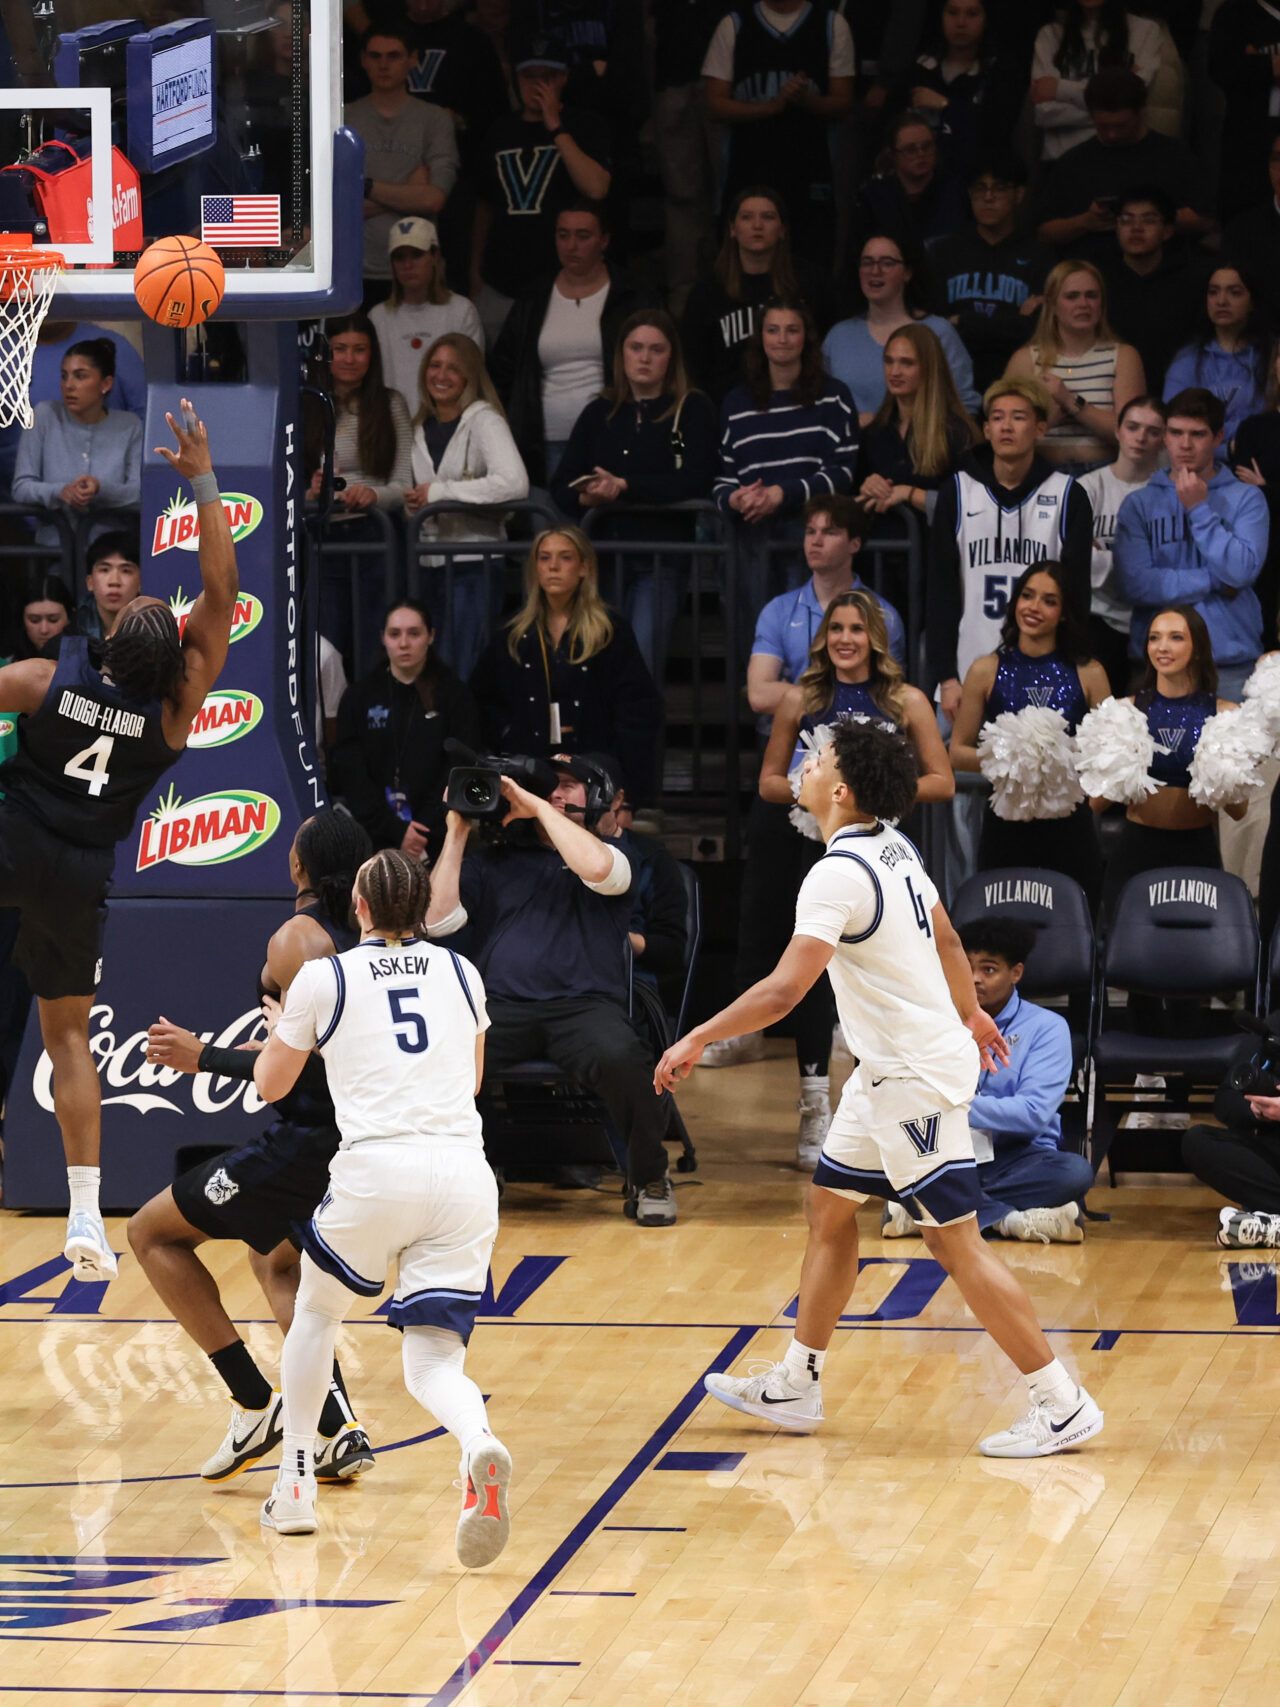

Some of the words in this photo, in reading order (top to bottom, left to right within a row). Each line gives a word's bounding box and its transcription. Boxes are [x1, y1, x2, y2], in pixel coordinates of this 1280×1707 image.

[155, 78, 190, 113] HARTFORD
[188, 69, 208, 99] FUNDS
[495, 146, 562, 215] V
[152, 502, 252, 555] LIBAN
[282, 424, 299, 709] HARTFORD
[58, 690, 146, 740] OLIOGU-ELABOR
[62, 734, 115, 798] 4
[137, 801, 269, 870] LIBMAN
[904, 875, 932, 939] 4
[984, 880, 1054, 911] VILLANOVA
[1149, 879, 1219, 911] VILLANOVA
[369, 955, 430, 981] ASKEW
[387, 988, 429, 1054] 5
[900, 1112, 941, 1158] V
